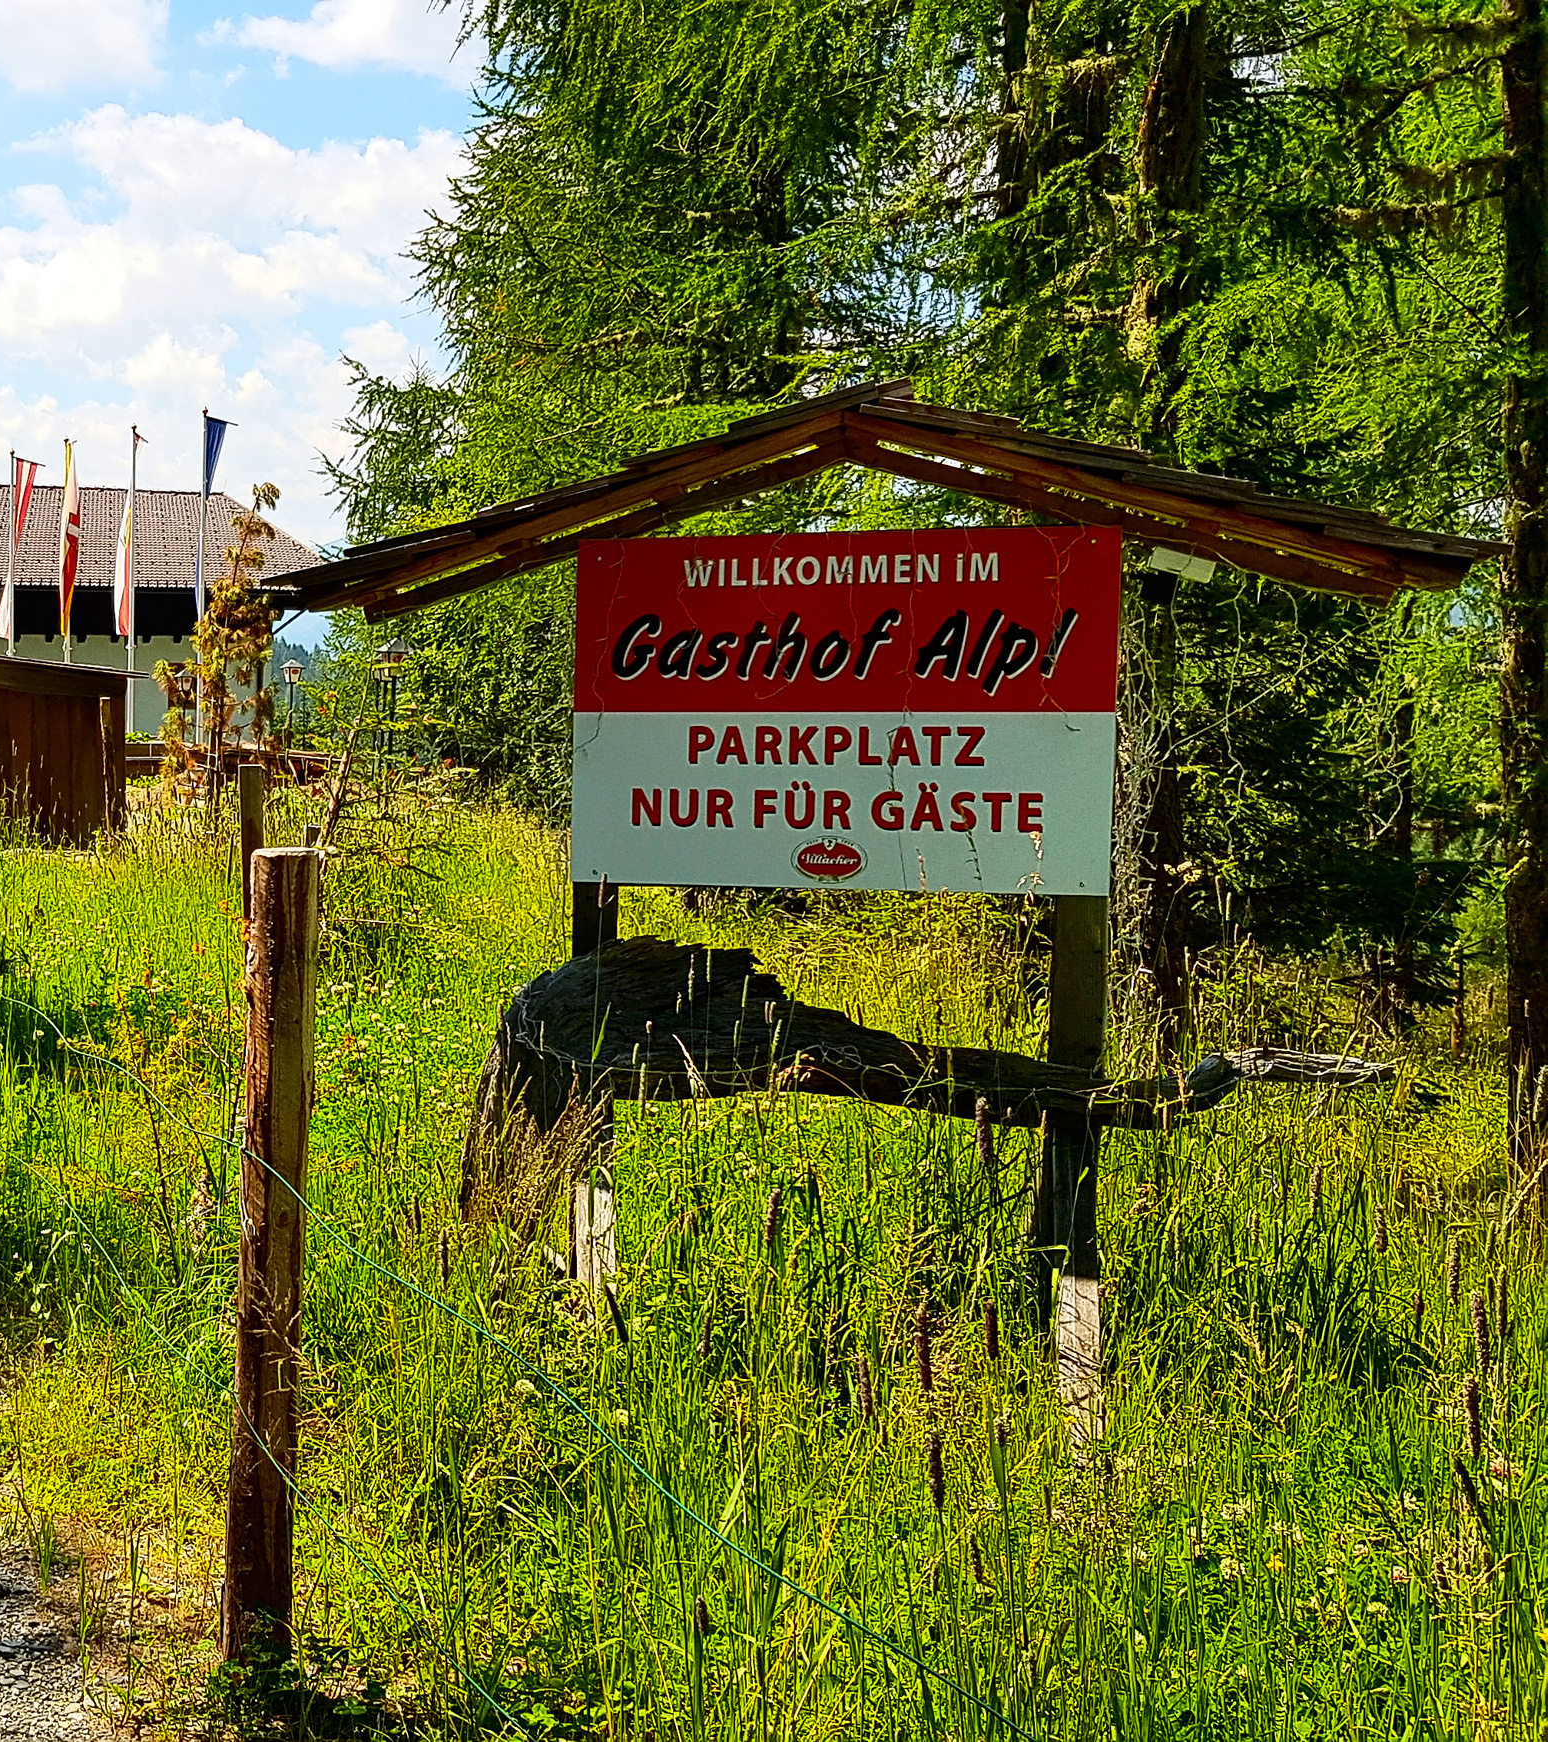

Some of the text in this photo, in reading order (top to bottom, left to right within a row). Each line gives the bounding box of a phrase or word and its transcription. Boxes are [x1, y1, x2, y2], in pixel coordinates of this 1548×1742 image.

[683, 553, 941, 588] WILLKOMMEN
[612, 608, 902, 684] Gasthof
[688, 725, 986, 767] PARKPLATZ
[631, 780, 1044, 834] NUR FÜR GÄSTE
